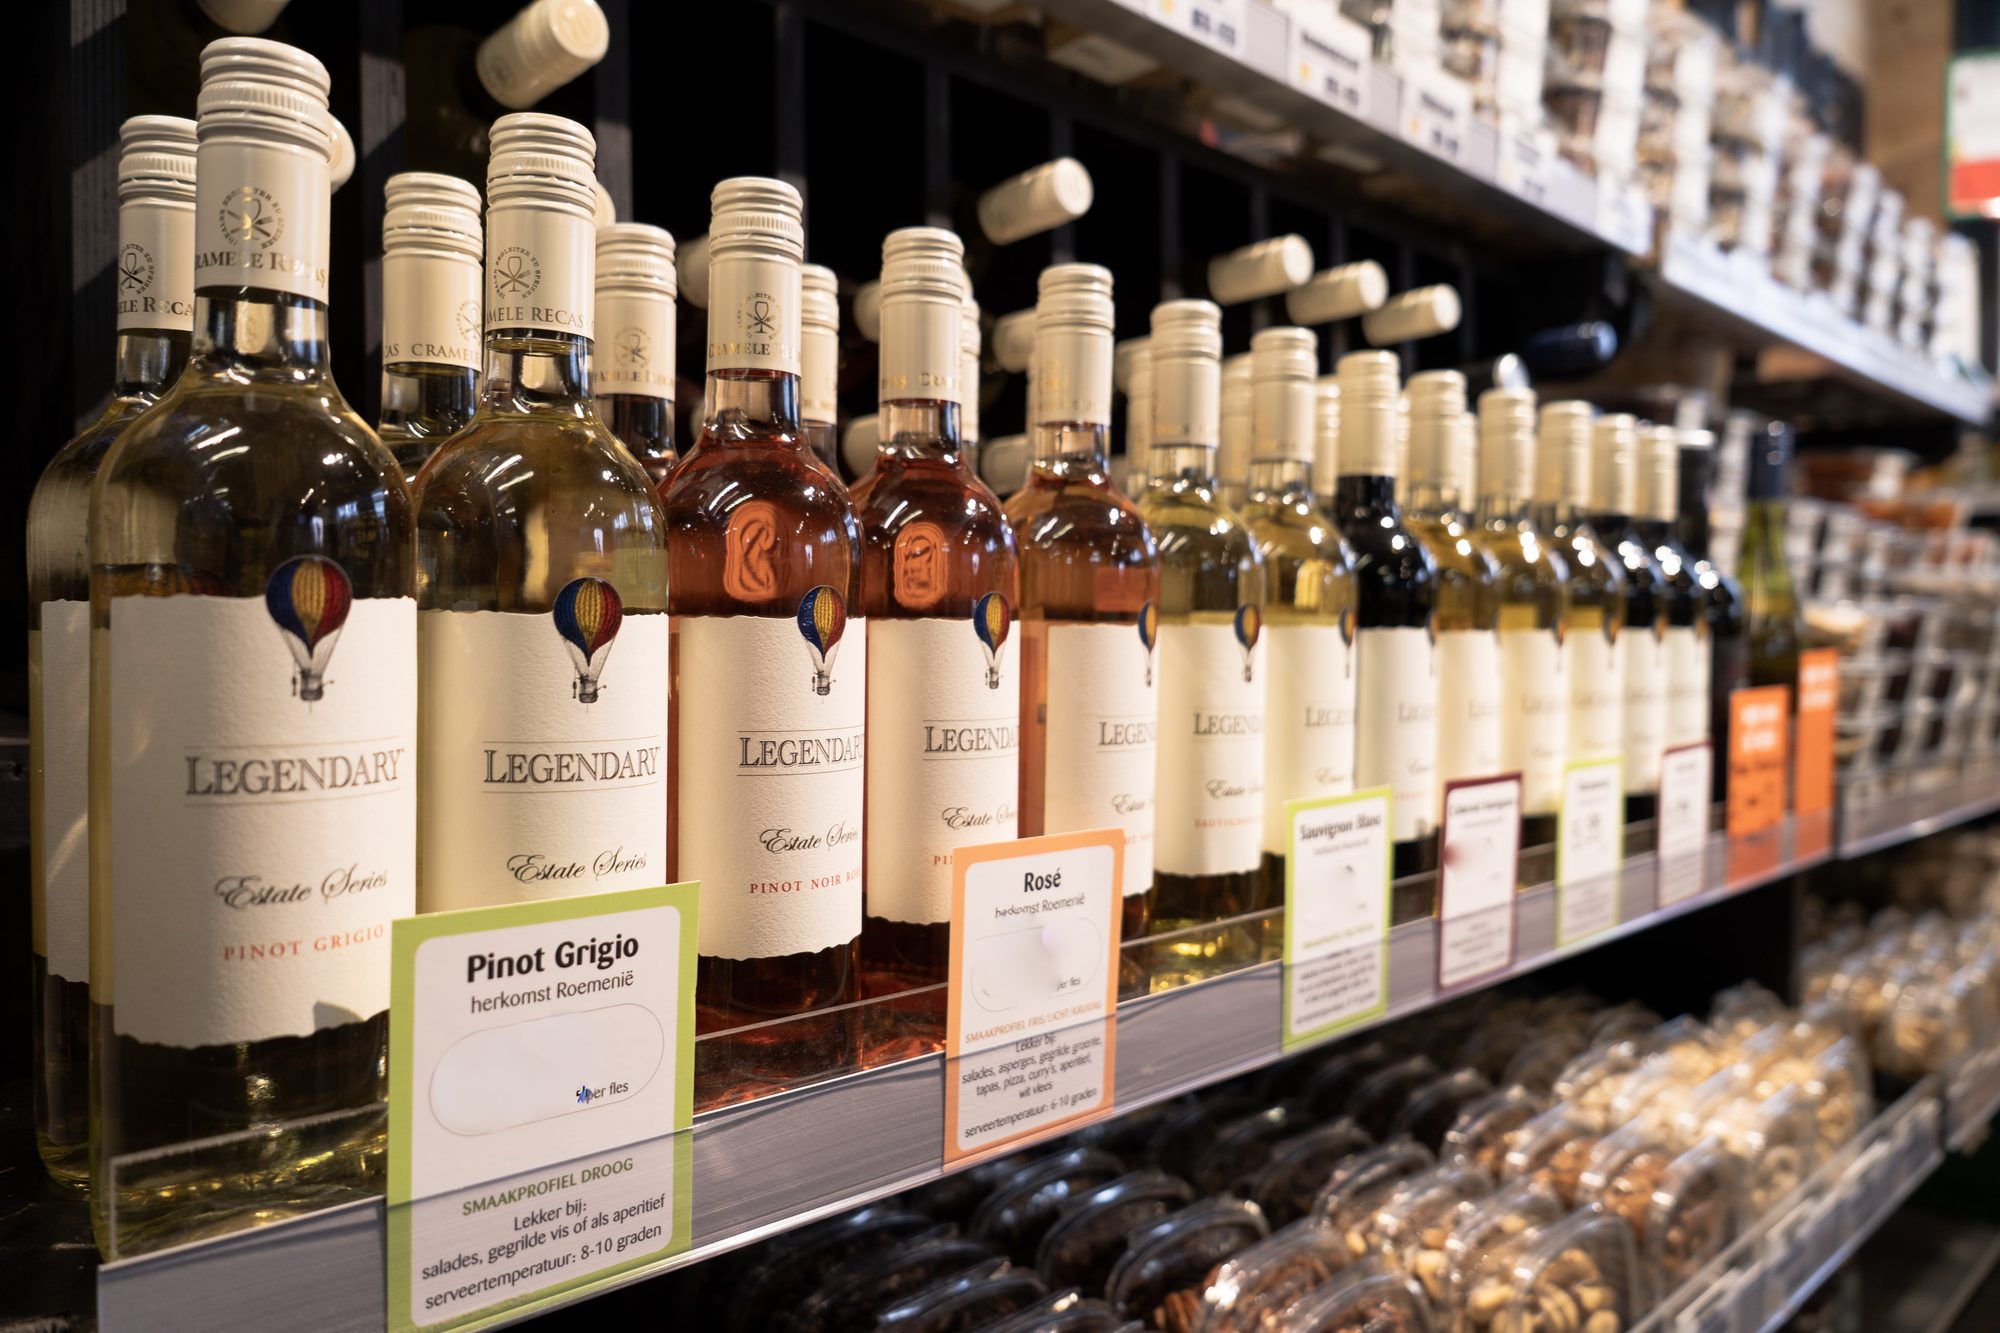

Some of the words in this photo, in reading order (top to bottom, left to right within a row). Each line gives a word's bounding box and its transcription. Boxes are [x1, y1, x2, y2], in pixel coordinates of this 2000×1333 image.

[530, 256, 540, 267] ZU
[531, 306, 585, 329] RECAS
[186, 748, 403, 796] LEGENDARY
[484, 746, 660, 784] LEGENDARY
[942, 806, 993, 830] Estate
[760, 828, 823, 855] Estate
[507, 855, 586, 884] Estate
[592, 846, 647, 882] Series
[1023, 867, 1062, 893] Rosé
[214, 875, 313, 911] Estate
[321, 863, 388, 905] Series
[750, 880, 803, 894] PINOT
[811, 874, 842, 890] NOIR
[223, 940, 302, 961] PINOT
[313, 925, 384, 951] GRIGIO
[467, 947, 545, 983] Pinot
[554, 933, 640, 970] Grigio
[470, 985, 552, 1014] herkomst
[556, 970, 635, 999] Roemenië
[1015, 1035, 1043, 1053] Lekker
[609, 1081, 629, 1095] fles
[962, 1066, 996, 1084] salades,
[976, 1081, 1002, 1097] tapas,
[462, 1172, 578, 1216] SMAAKPROFIEL
[581, 1157, 635, 1184] DROOG
[514, 1207, 563, 1231] Lekker
[565, 1199, 588, 1218] bij:
[421, 1252, 484, 1280] salades,
[487, 1231, 547, 1265] gegrilde
[550, 1225, 570, 1242] vis
[573, 1216, 589, 1235] of
[590, 1212, 610, 1230] als
[612, 1193, 667, 1225] aperitief
[425, 1252, 577, 1310] serveertemperatuur:
[580, 1237, 614, 1260] 8-10
[616, 1224, 662, 1253] graden
